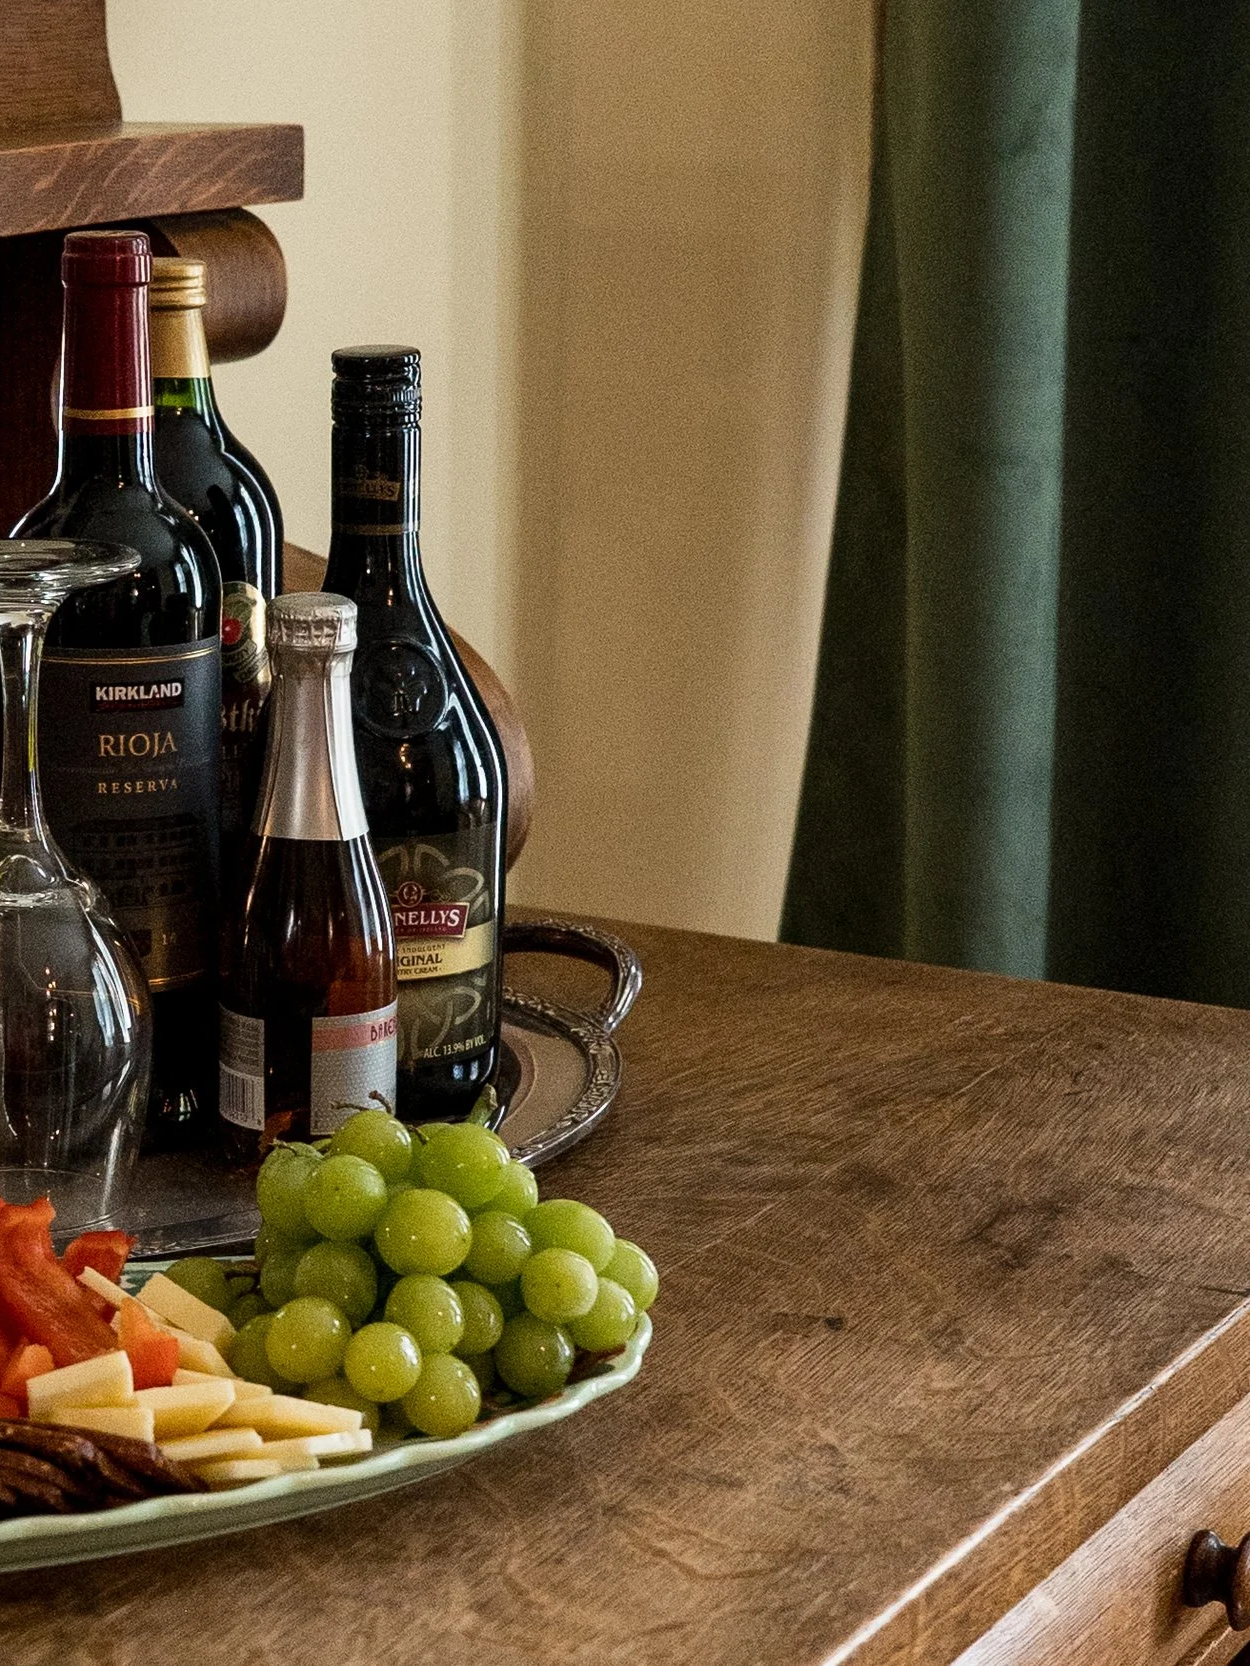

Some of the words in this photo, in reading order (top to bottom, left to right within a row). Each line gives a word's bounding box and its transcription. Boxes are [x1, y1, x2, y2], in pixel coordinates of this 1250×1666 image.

[95, 682, 182, 701] KIRKLAND
[97, 731, 178, 758] RIOJA
[97, 779, 178, 793] RESERVA
[443, 1042, 465, 1055] 13.9%
